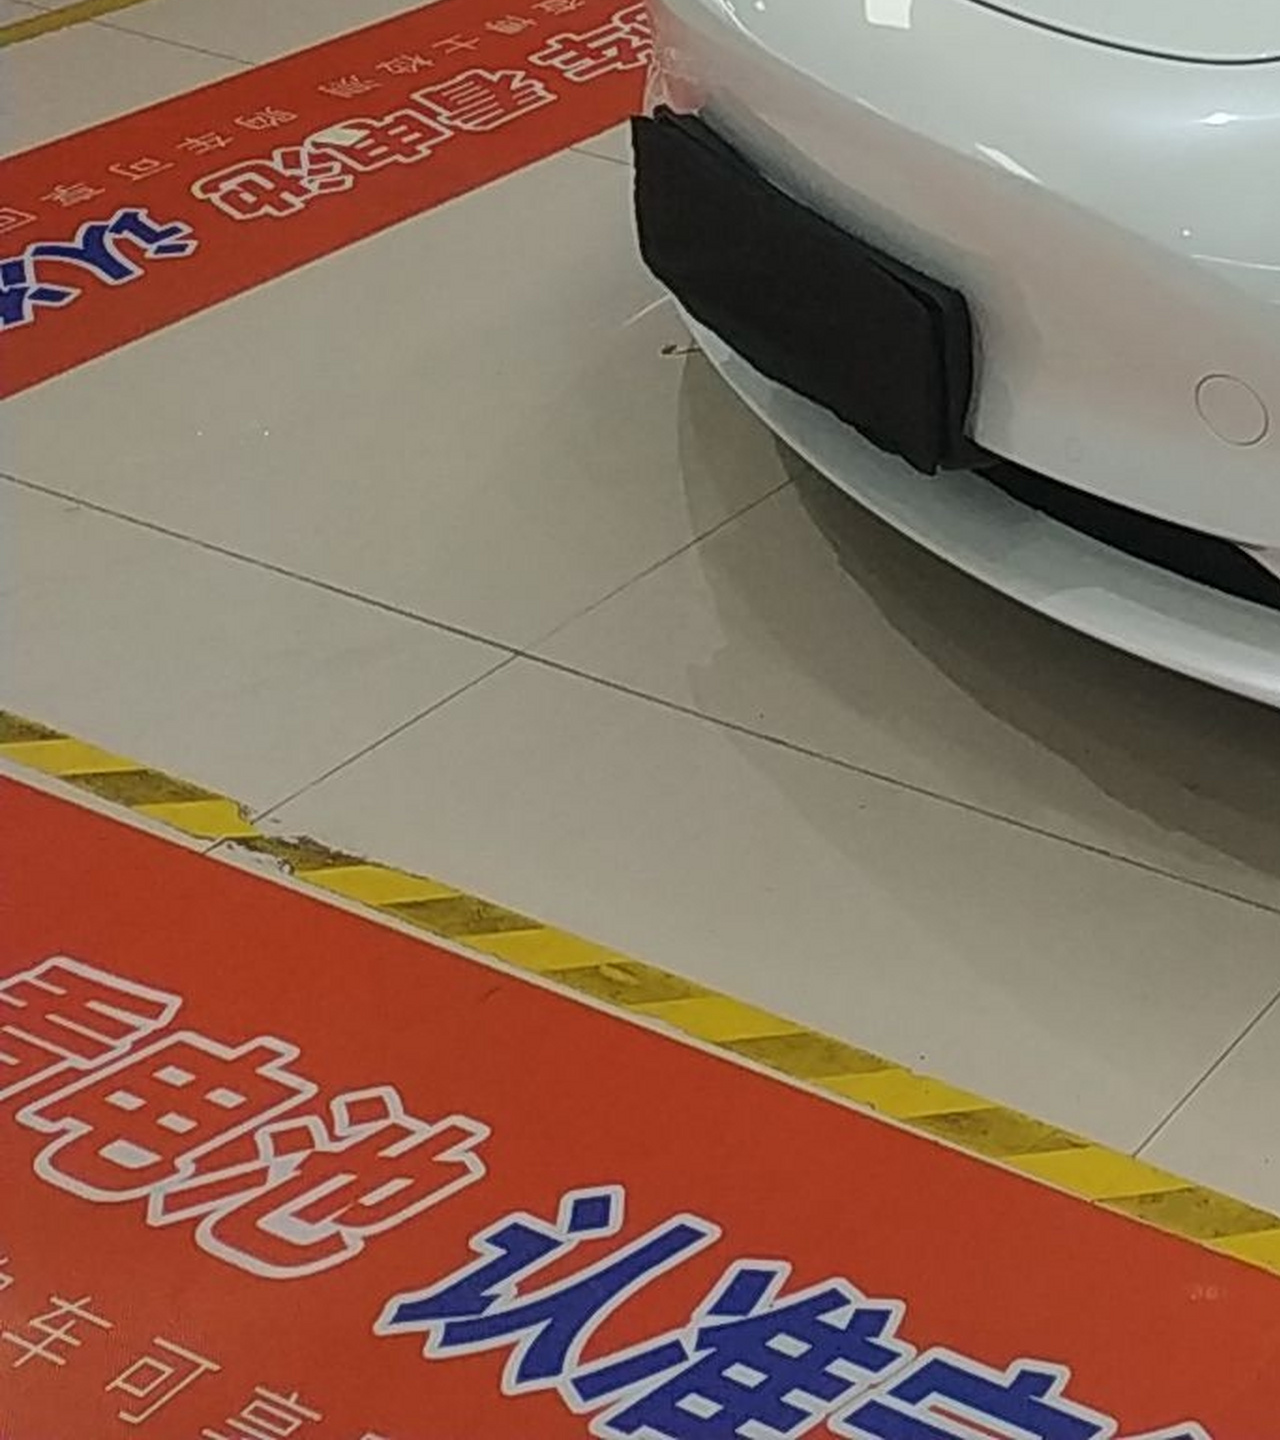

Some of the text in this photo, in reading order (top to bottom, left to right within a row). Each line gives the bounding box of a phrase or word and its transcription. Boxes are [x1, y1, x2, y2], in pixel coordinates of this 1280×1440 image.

[0, 1253, 386, 1440] 车可享
[373, 1183, 1214, 1440] 认准
